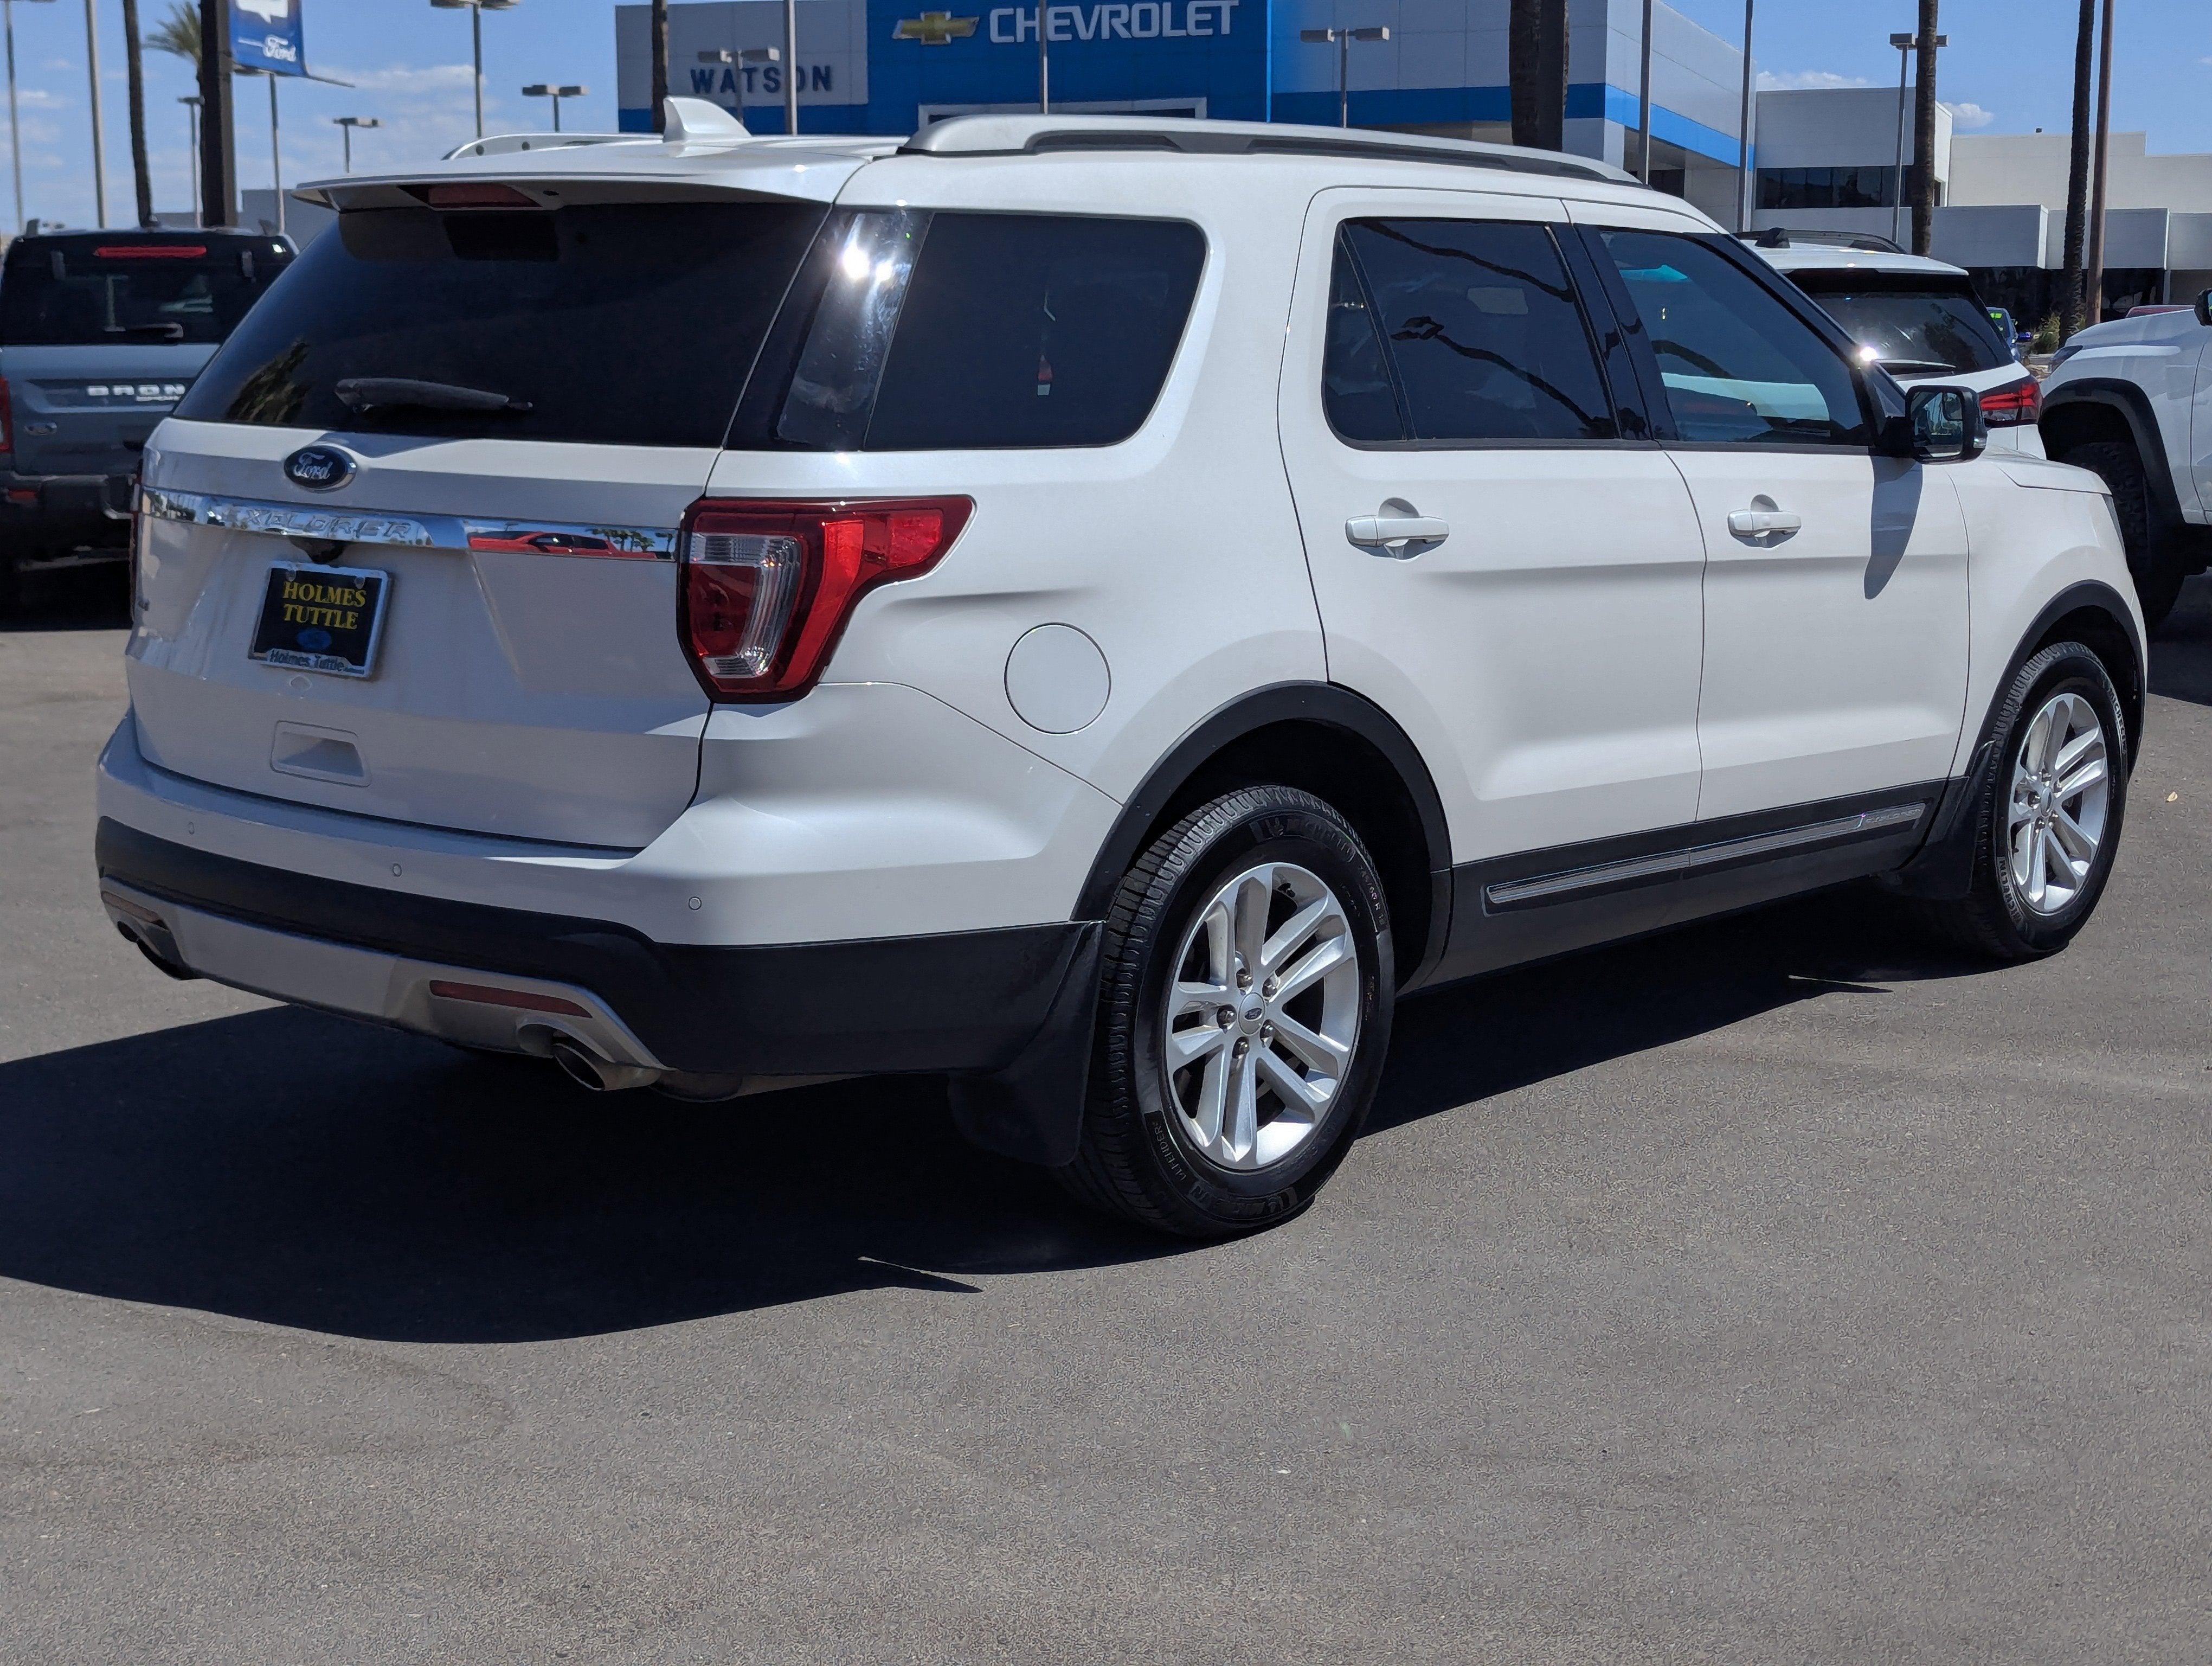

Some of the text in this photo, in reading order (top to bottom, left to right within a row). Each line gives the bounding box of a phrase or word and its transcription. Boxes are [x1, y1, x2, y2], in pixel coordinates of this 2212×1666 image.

[989, 0, 1239, 43] CHEVROLET
[263, 35, 297, 62] Ford
[294, 452, 333, 479] Ford
[282, 581, 367, 607] HOLMES
[283, 603, 359, 630] TUTTLE
[270, 649, 345, 672] Holmes Tuttle
